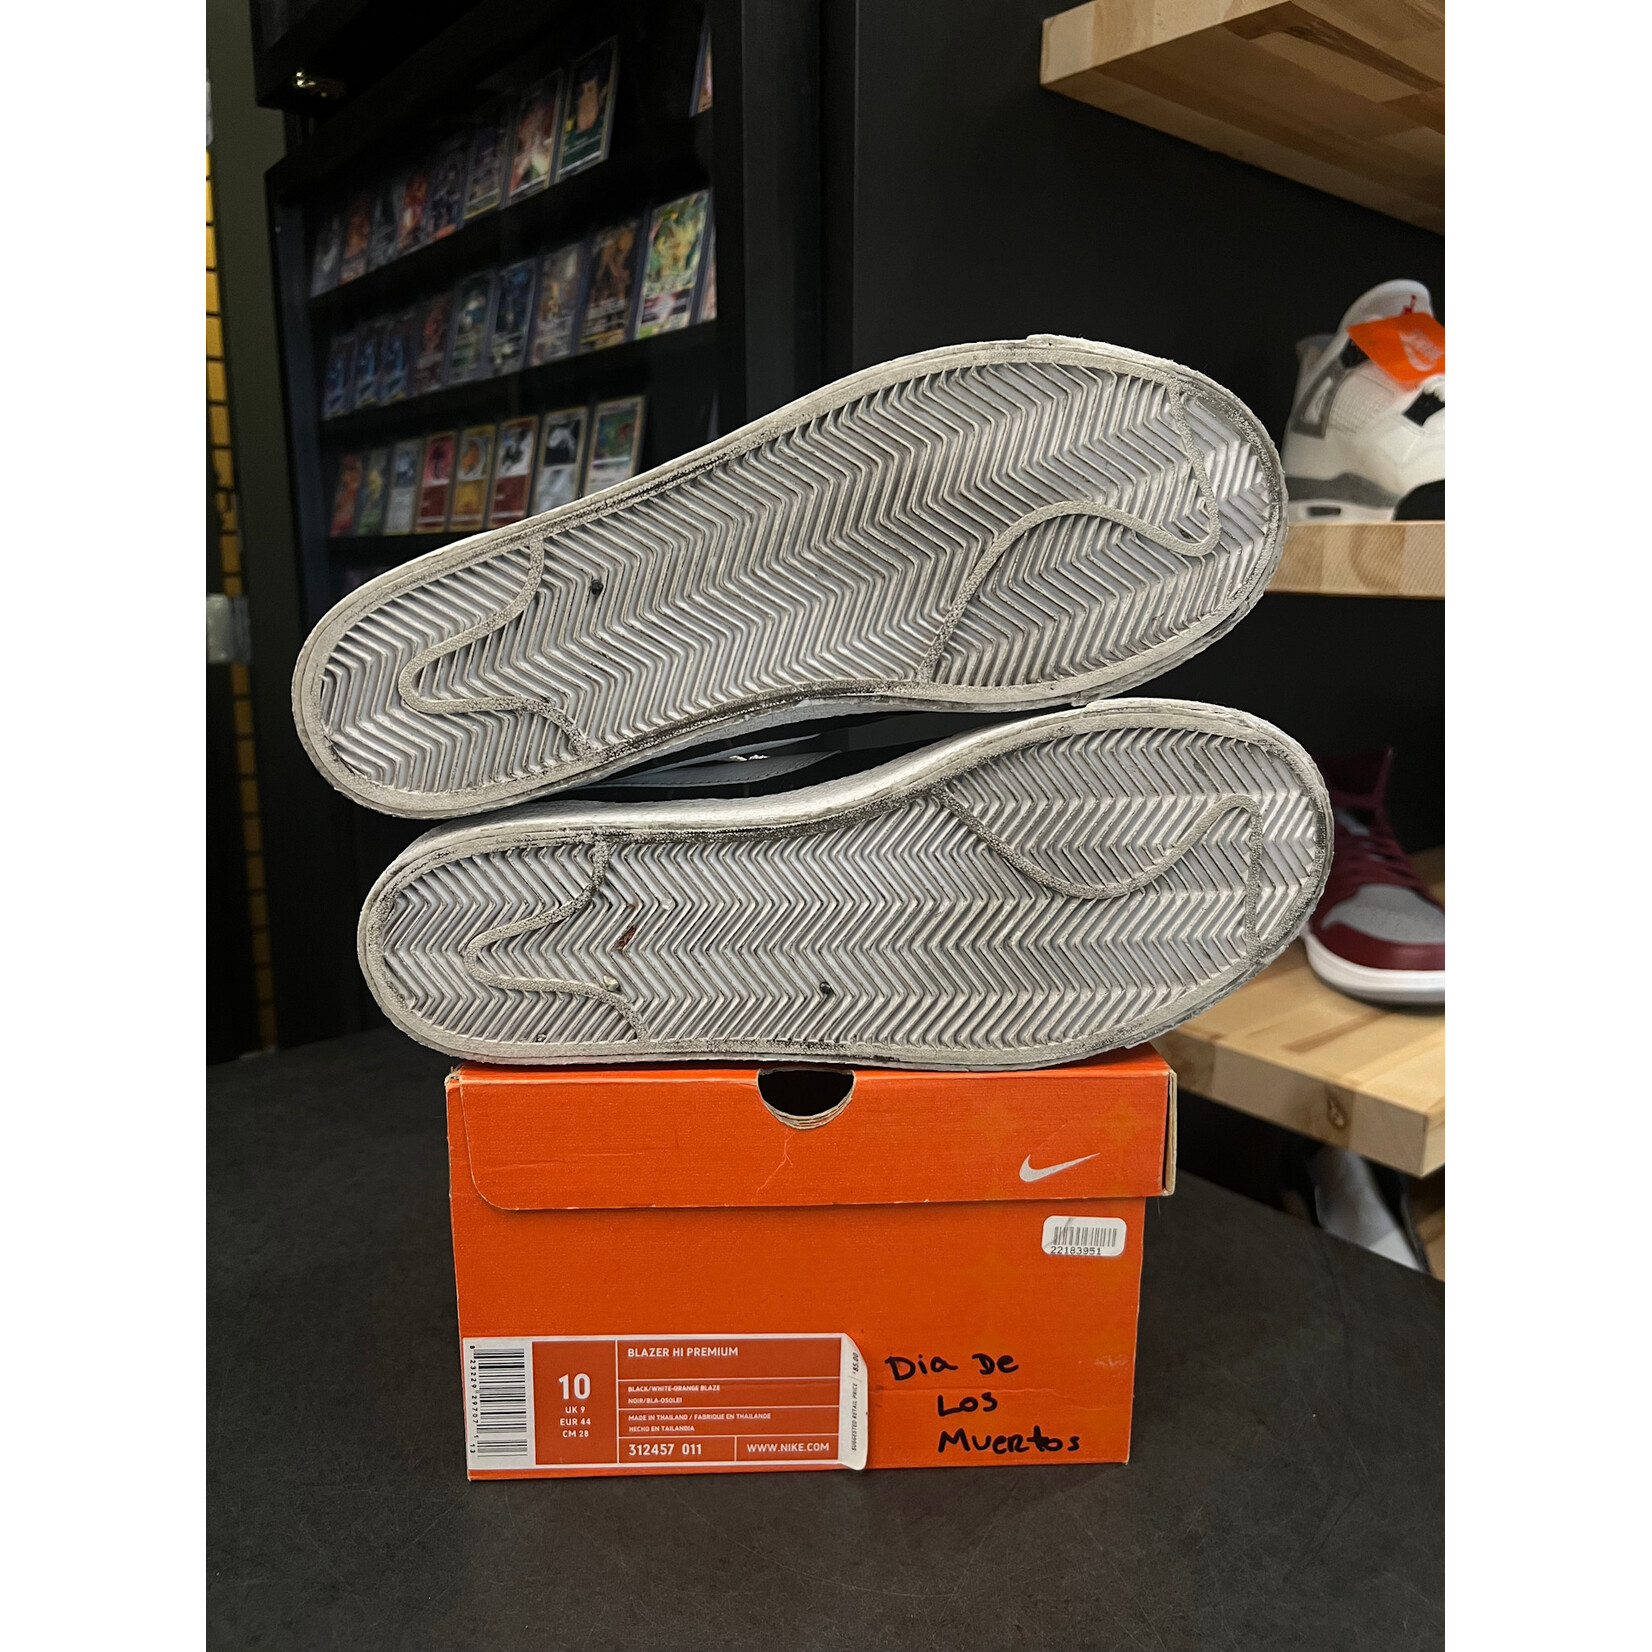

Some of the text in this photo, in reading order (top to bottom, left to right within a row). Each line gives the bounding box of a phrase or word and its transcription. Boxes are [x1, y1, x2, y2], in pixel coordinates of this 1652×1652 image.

[1050, 1246, 1102, 1255] 22183951
[627, 1346, 739, 1358] BLAZER HI PREMIUM
[884, 1353, 1019, 1381] Dia De
[558, 1372, 591, 1400] 10
[627, 1384, 720, 1393] BLACK/WHITE-ORANGE BLAZE
[471, 1395, 479, 1424] 29707
[565, 1406, 578, 1414] UK
[656, 1413, 688, 1421] THAILAND
[736, 1412, 771, 1420] THAILANDE
[560, 1418, 578, 1426] EUR
[562, 1430, 577, 1438] CM
[628, 1443, 702, 1456] 312457 011
[746, 1442, 830, 1453] WWW.NIKE.COM
